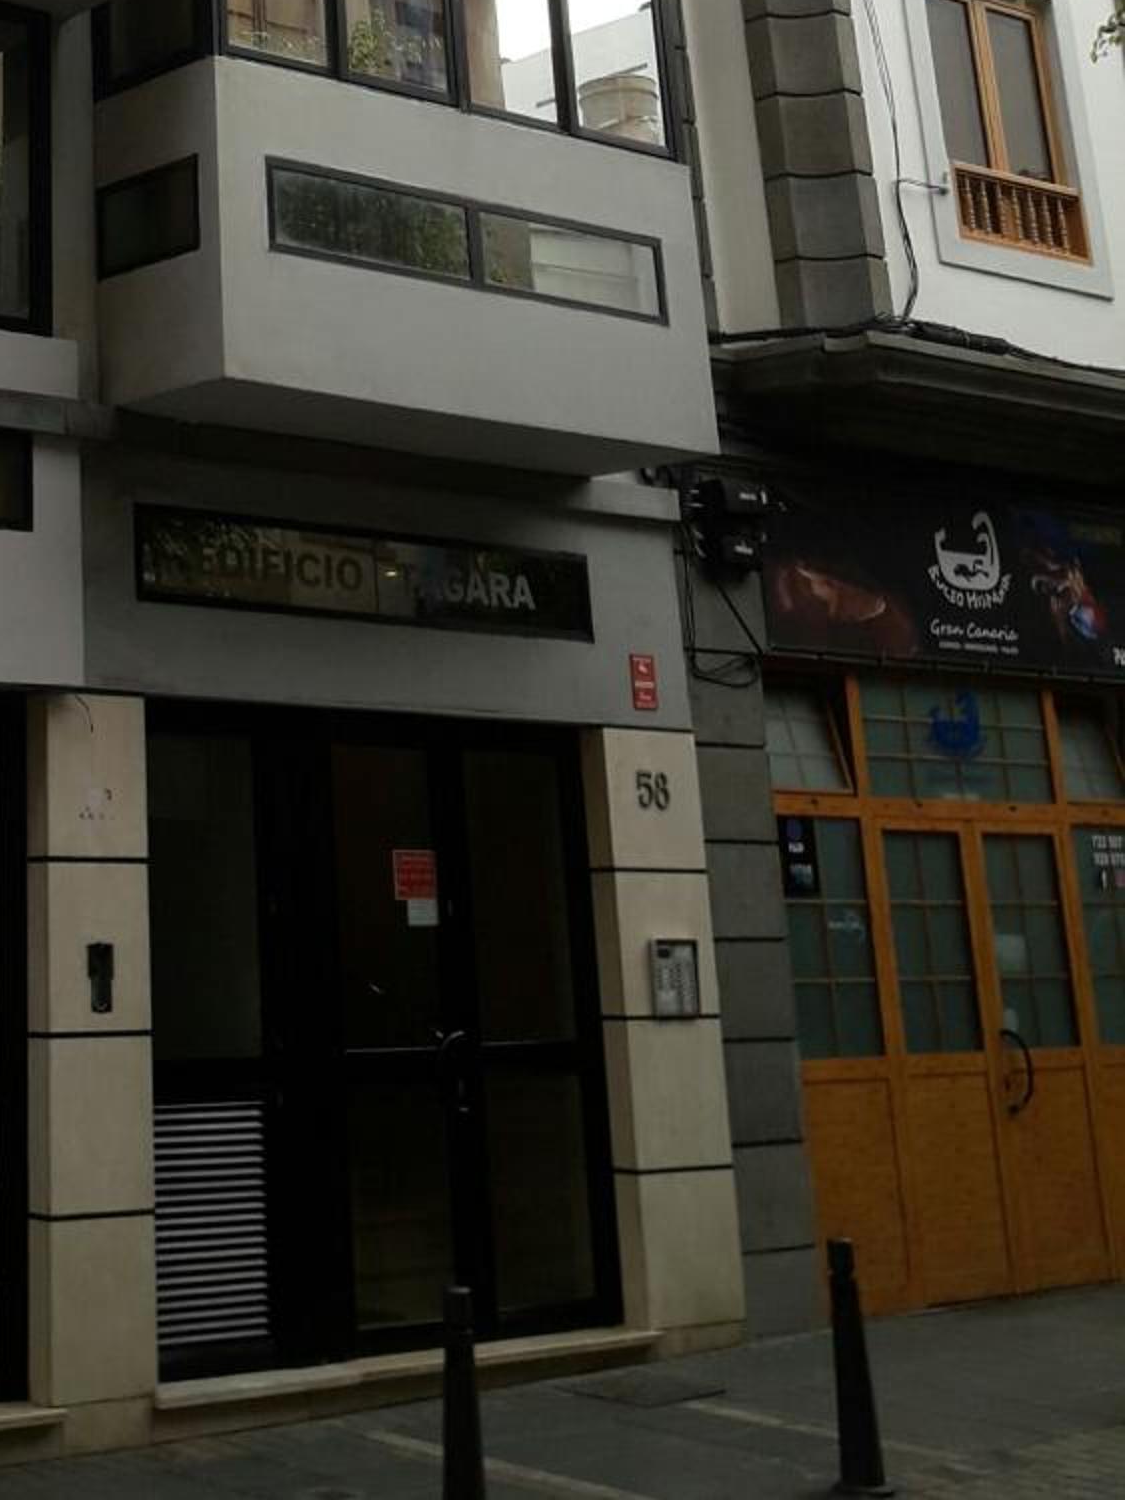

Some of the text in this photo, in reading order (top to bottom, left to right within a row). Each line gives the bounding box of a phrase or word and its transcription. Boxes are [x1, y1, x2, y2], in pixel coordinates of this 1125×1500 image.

[201, 545, 538, 611] EDIFICIO GARA
[930, 617, 1020, 642] Gran Canaria
[636, 769, 670, 810] 58
